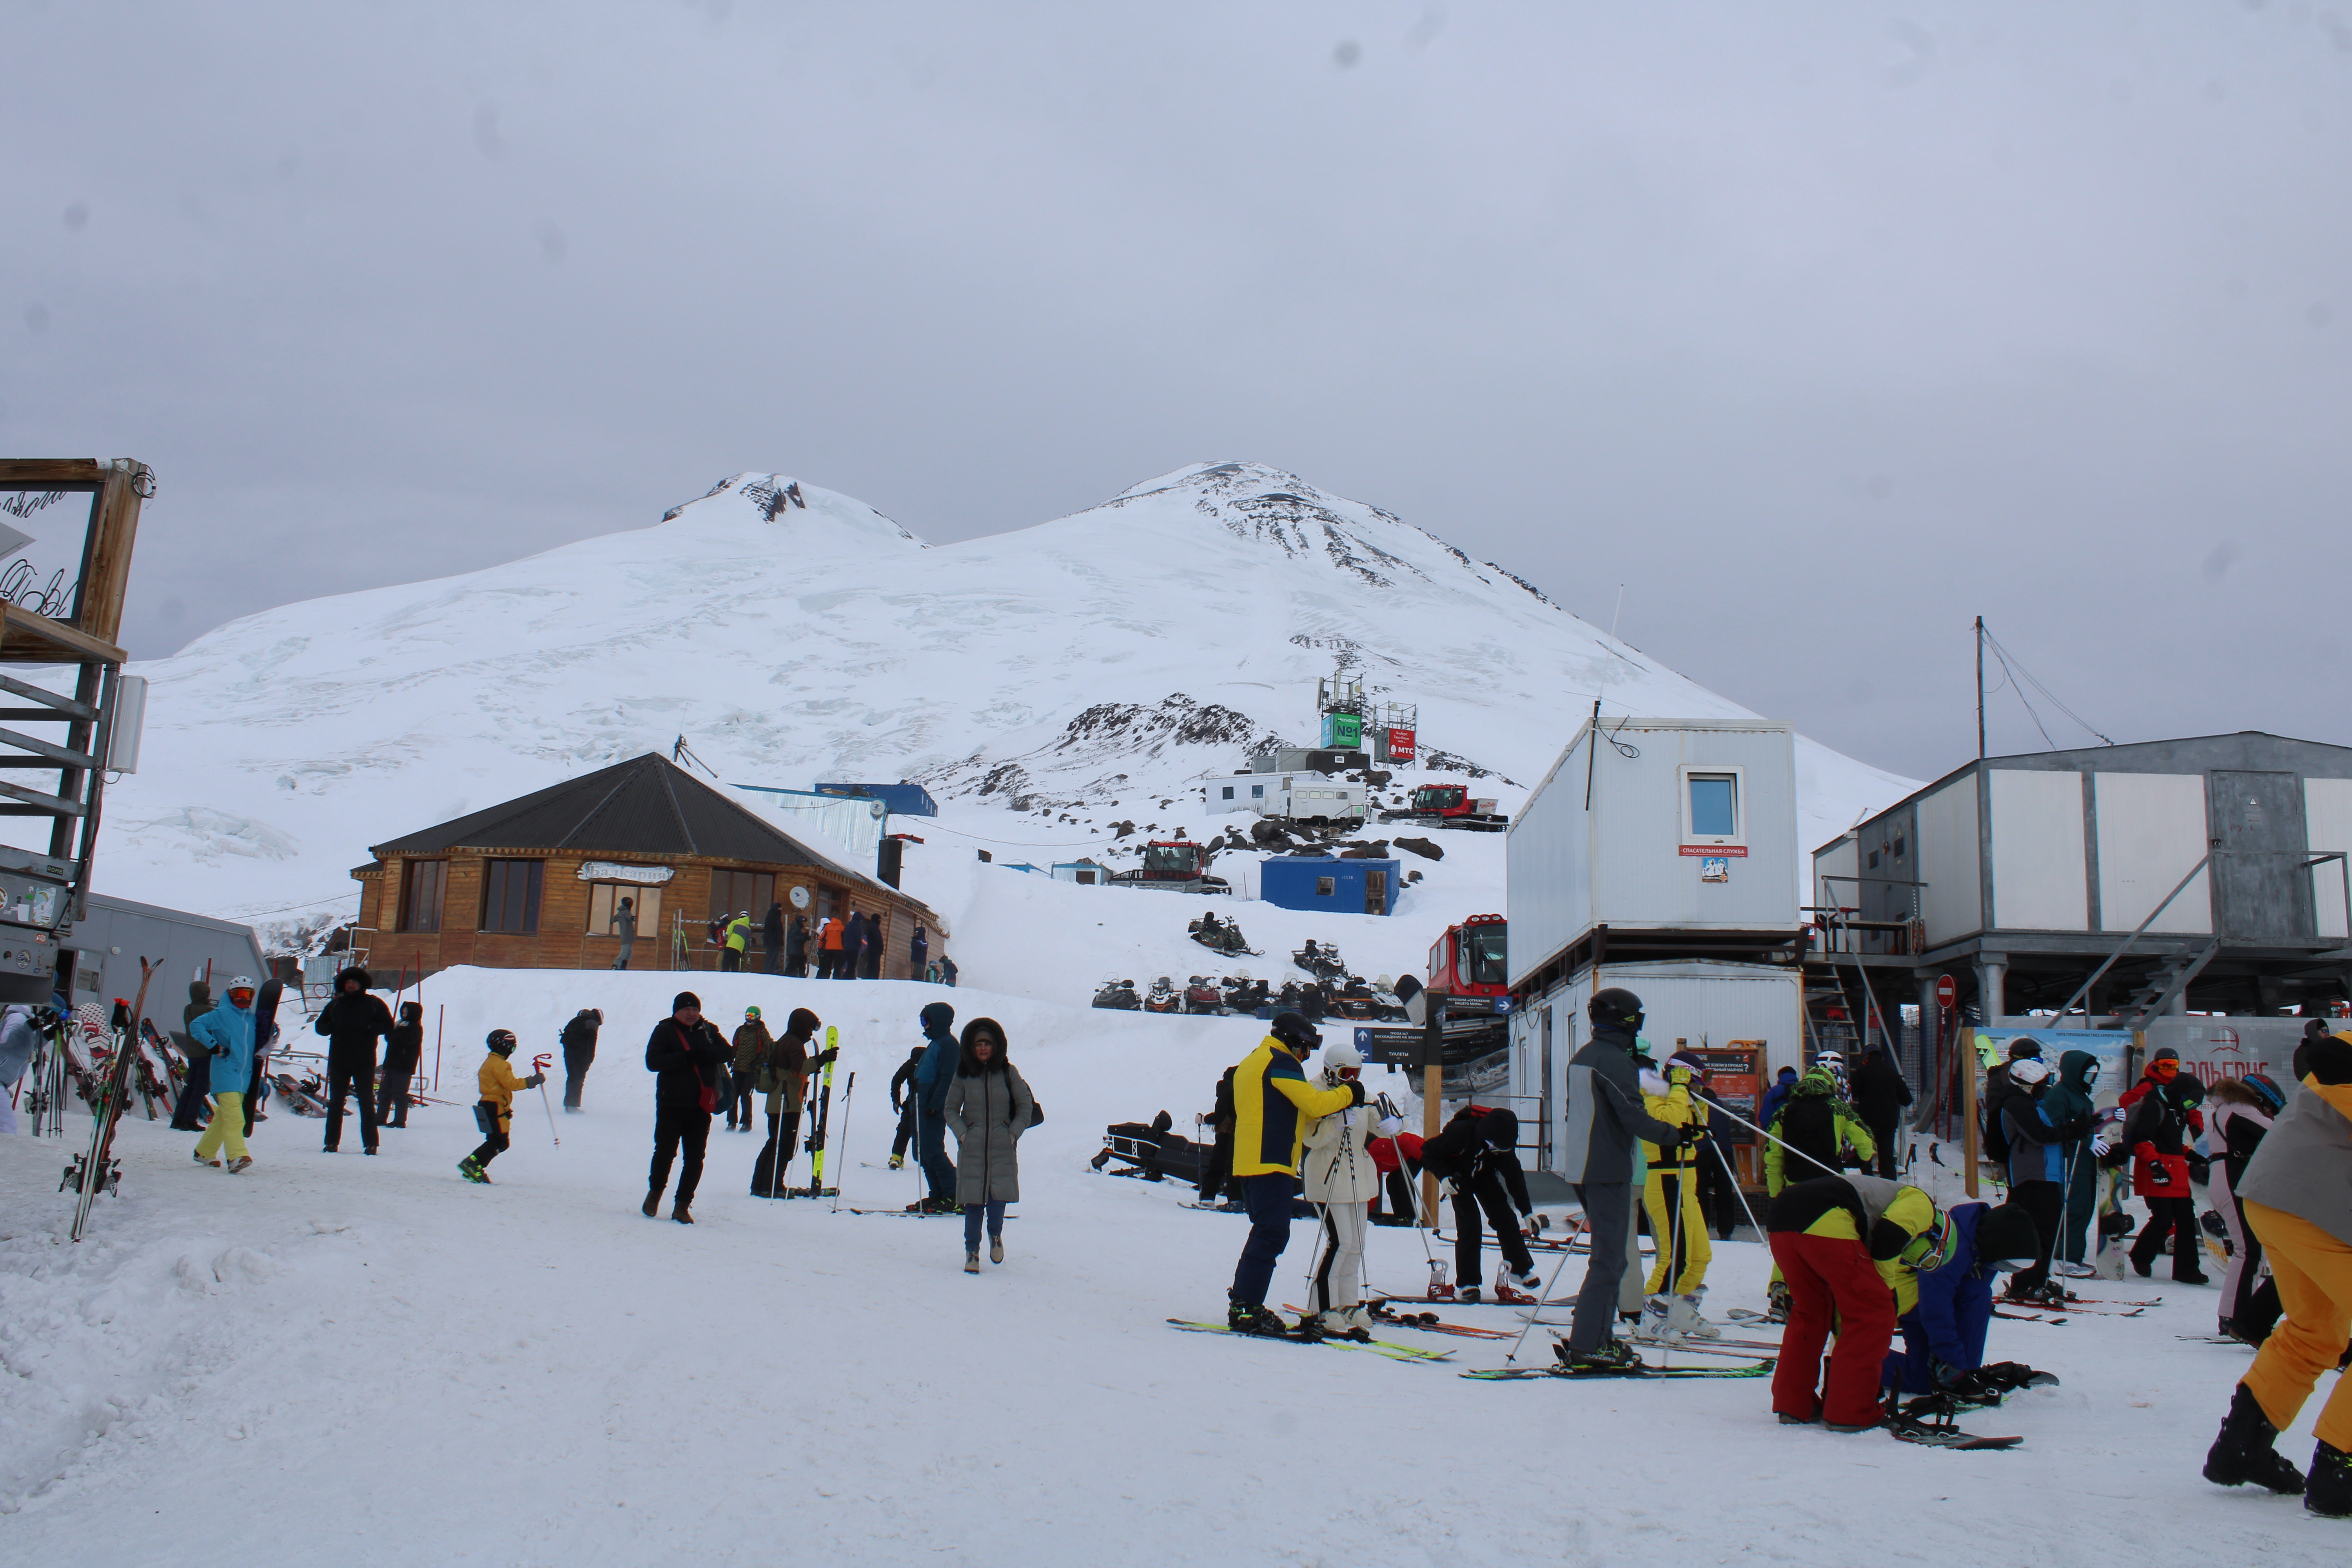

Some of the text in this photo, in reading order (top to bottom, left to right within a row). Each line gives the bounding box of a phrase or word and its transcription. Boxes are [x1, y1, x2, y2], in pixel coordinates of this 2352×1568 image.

[1338, 725, 1358, 738] №1
[1398, 746, 1414, 755] МТС
[47, 866, 63, 875] ROMB
[589, 866, 667, 880] Балкария
[2254, 1080, 2275, 1099] DRAGON
